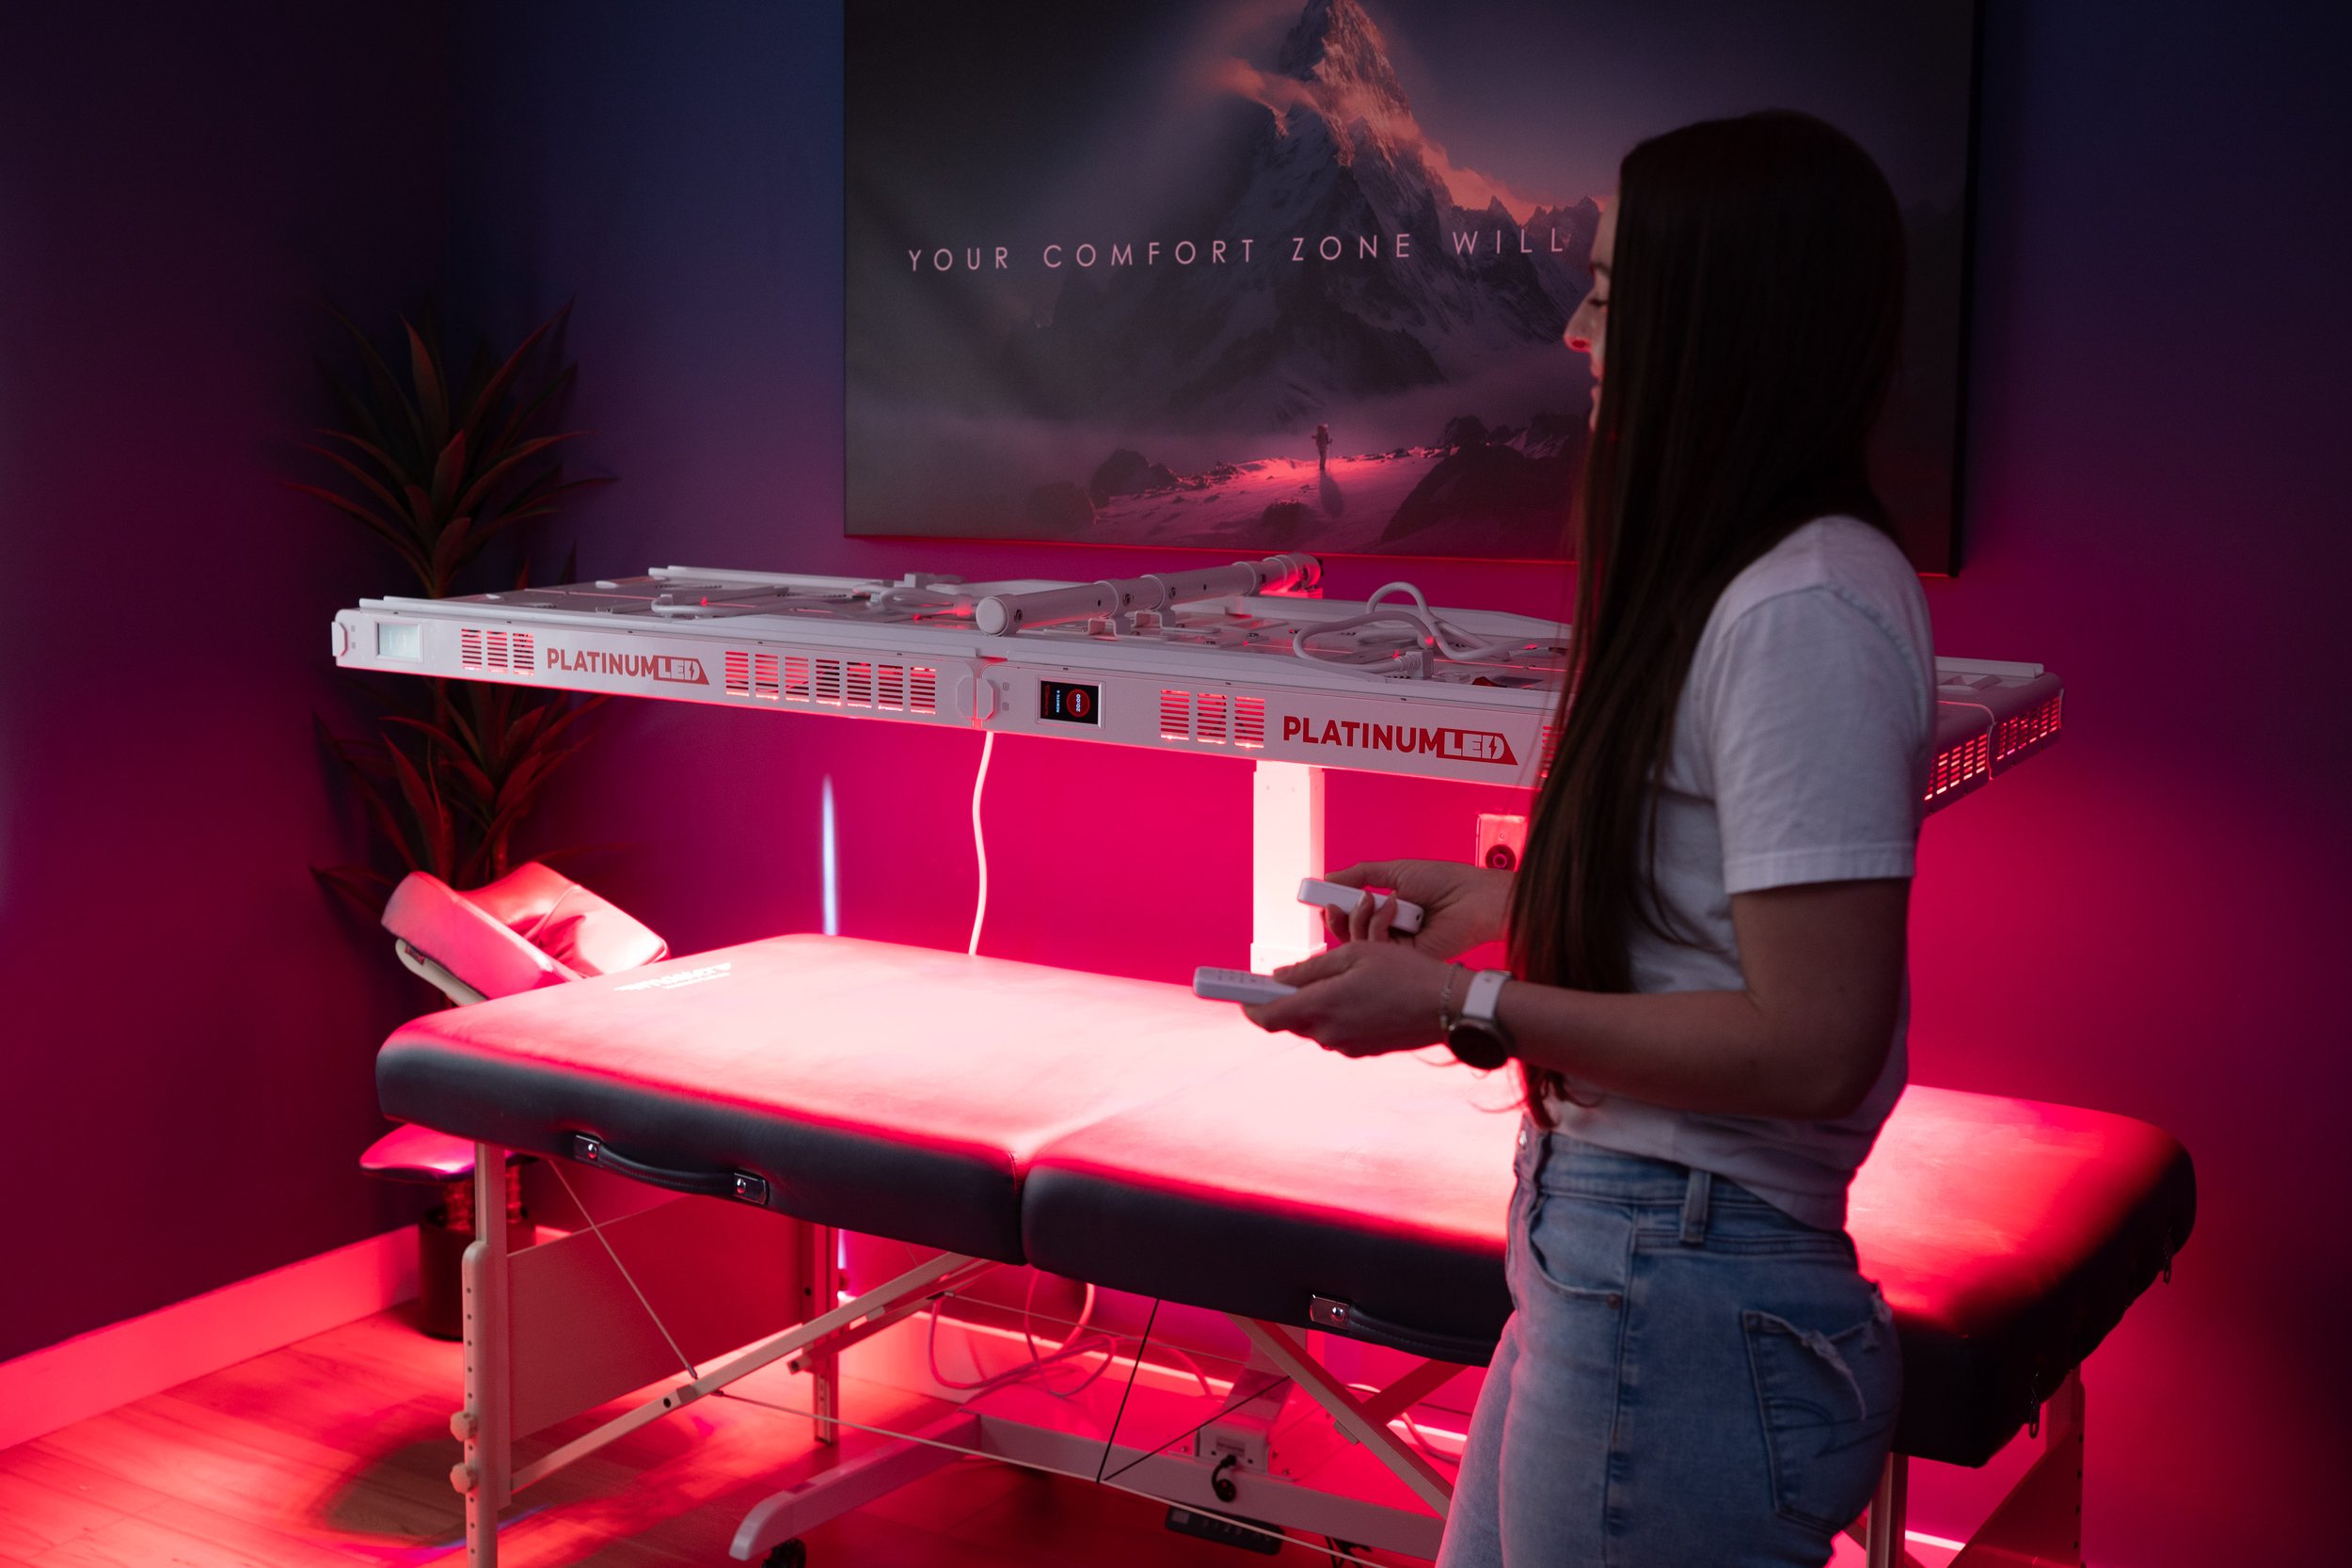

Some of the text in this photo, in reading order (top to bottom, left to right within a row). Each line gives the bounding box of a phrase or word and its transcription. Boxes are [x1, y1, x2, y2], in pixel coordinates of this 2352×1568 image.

[908, 227, 1564, 272] YOUR COMFORT ZONE WILL
